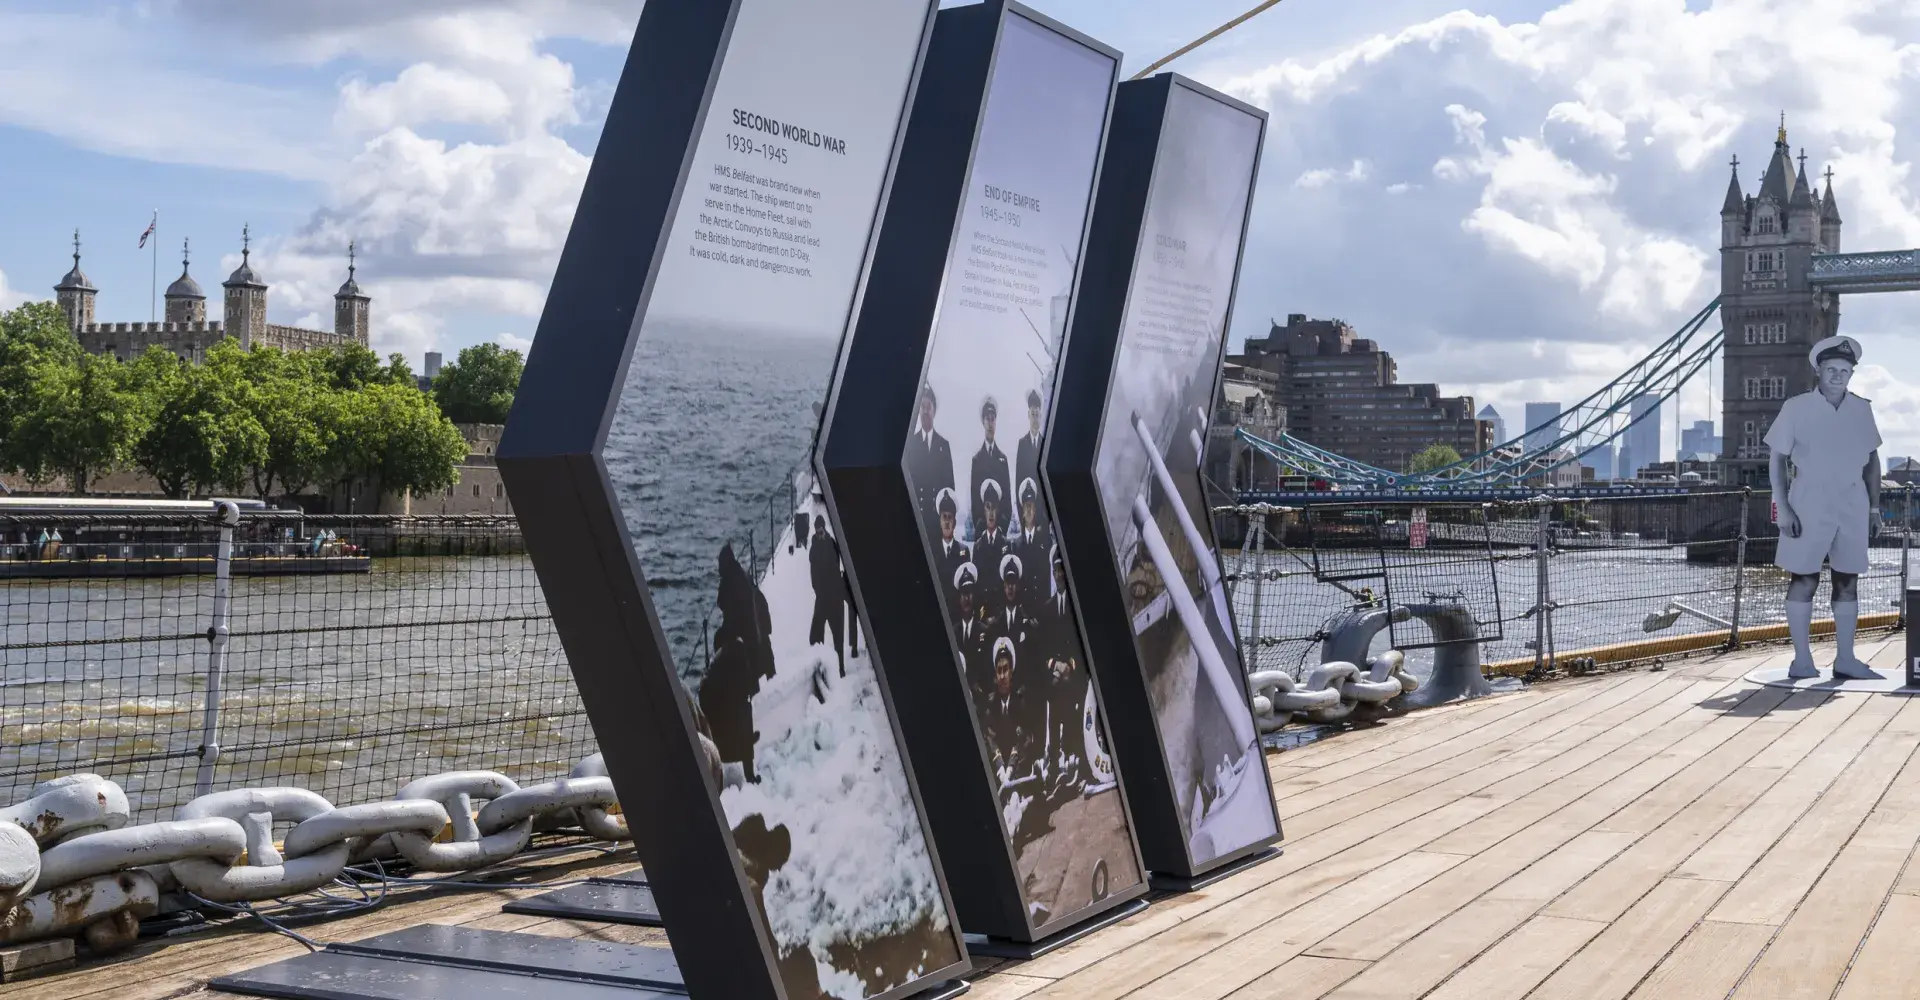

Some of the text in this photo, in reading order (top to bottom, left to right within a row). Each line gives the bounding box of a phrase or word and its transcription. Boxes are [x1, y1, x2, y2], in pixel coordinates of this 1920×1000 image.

[733, 109, 846, 155] SECOND WORLD WAR
[714, 164, 820, 199] HMS Belfast was brand new when
[710, 183, 812, 213] war started. The ship went on to
[985, 185, 1040, 212] END OF EMPIRE
[705, 199, 723, 210] serve
[725, 201, 731, 211] in
[733, 203, 744, 214] the
[746, 206, 766, 219] Home
[787, 215, 796, 225] sail
[798, 217, 811, 229] with
[695, 230, 707, 241] the
[709, 232, 730, 246] British
[732, 237, 779, 255] bombardment
[780, 247, 789, 256] on
[700, 214, 820, 247] the Arctic Convoys to Russia and lead
[690, 246, 695, 256] It
[697, 249, 710, 258] was
[730, 253, 745, 266] dark
[746, 257, 758, 268] and
[760, 258, 794, 274] dangerous
[795, 266, 812, 277] work.
